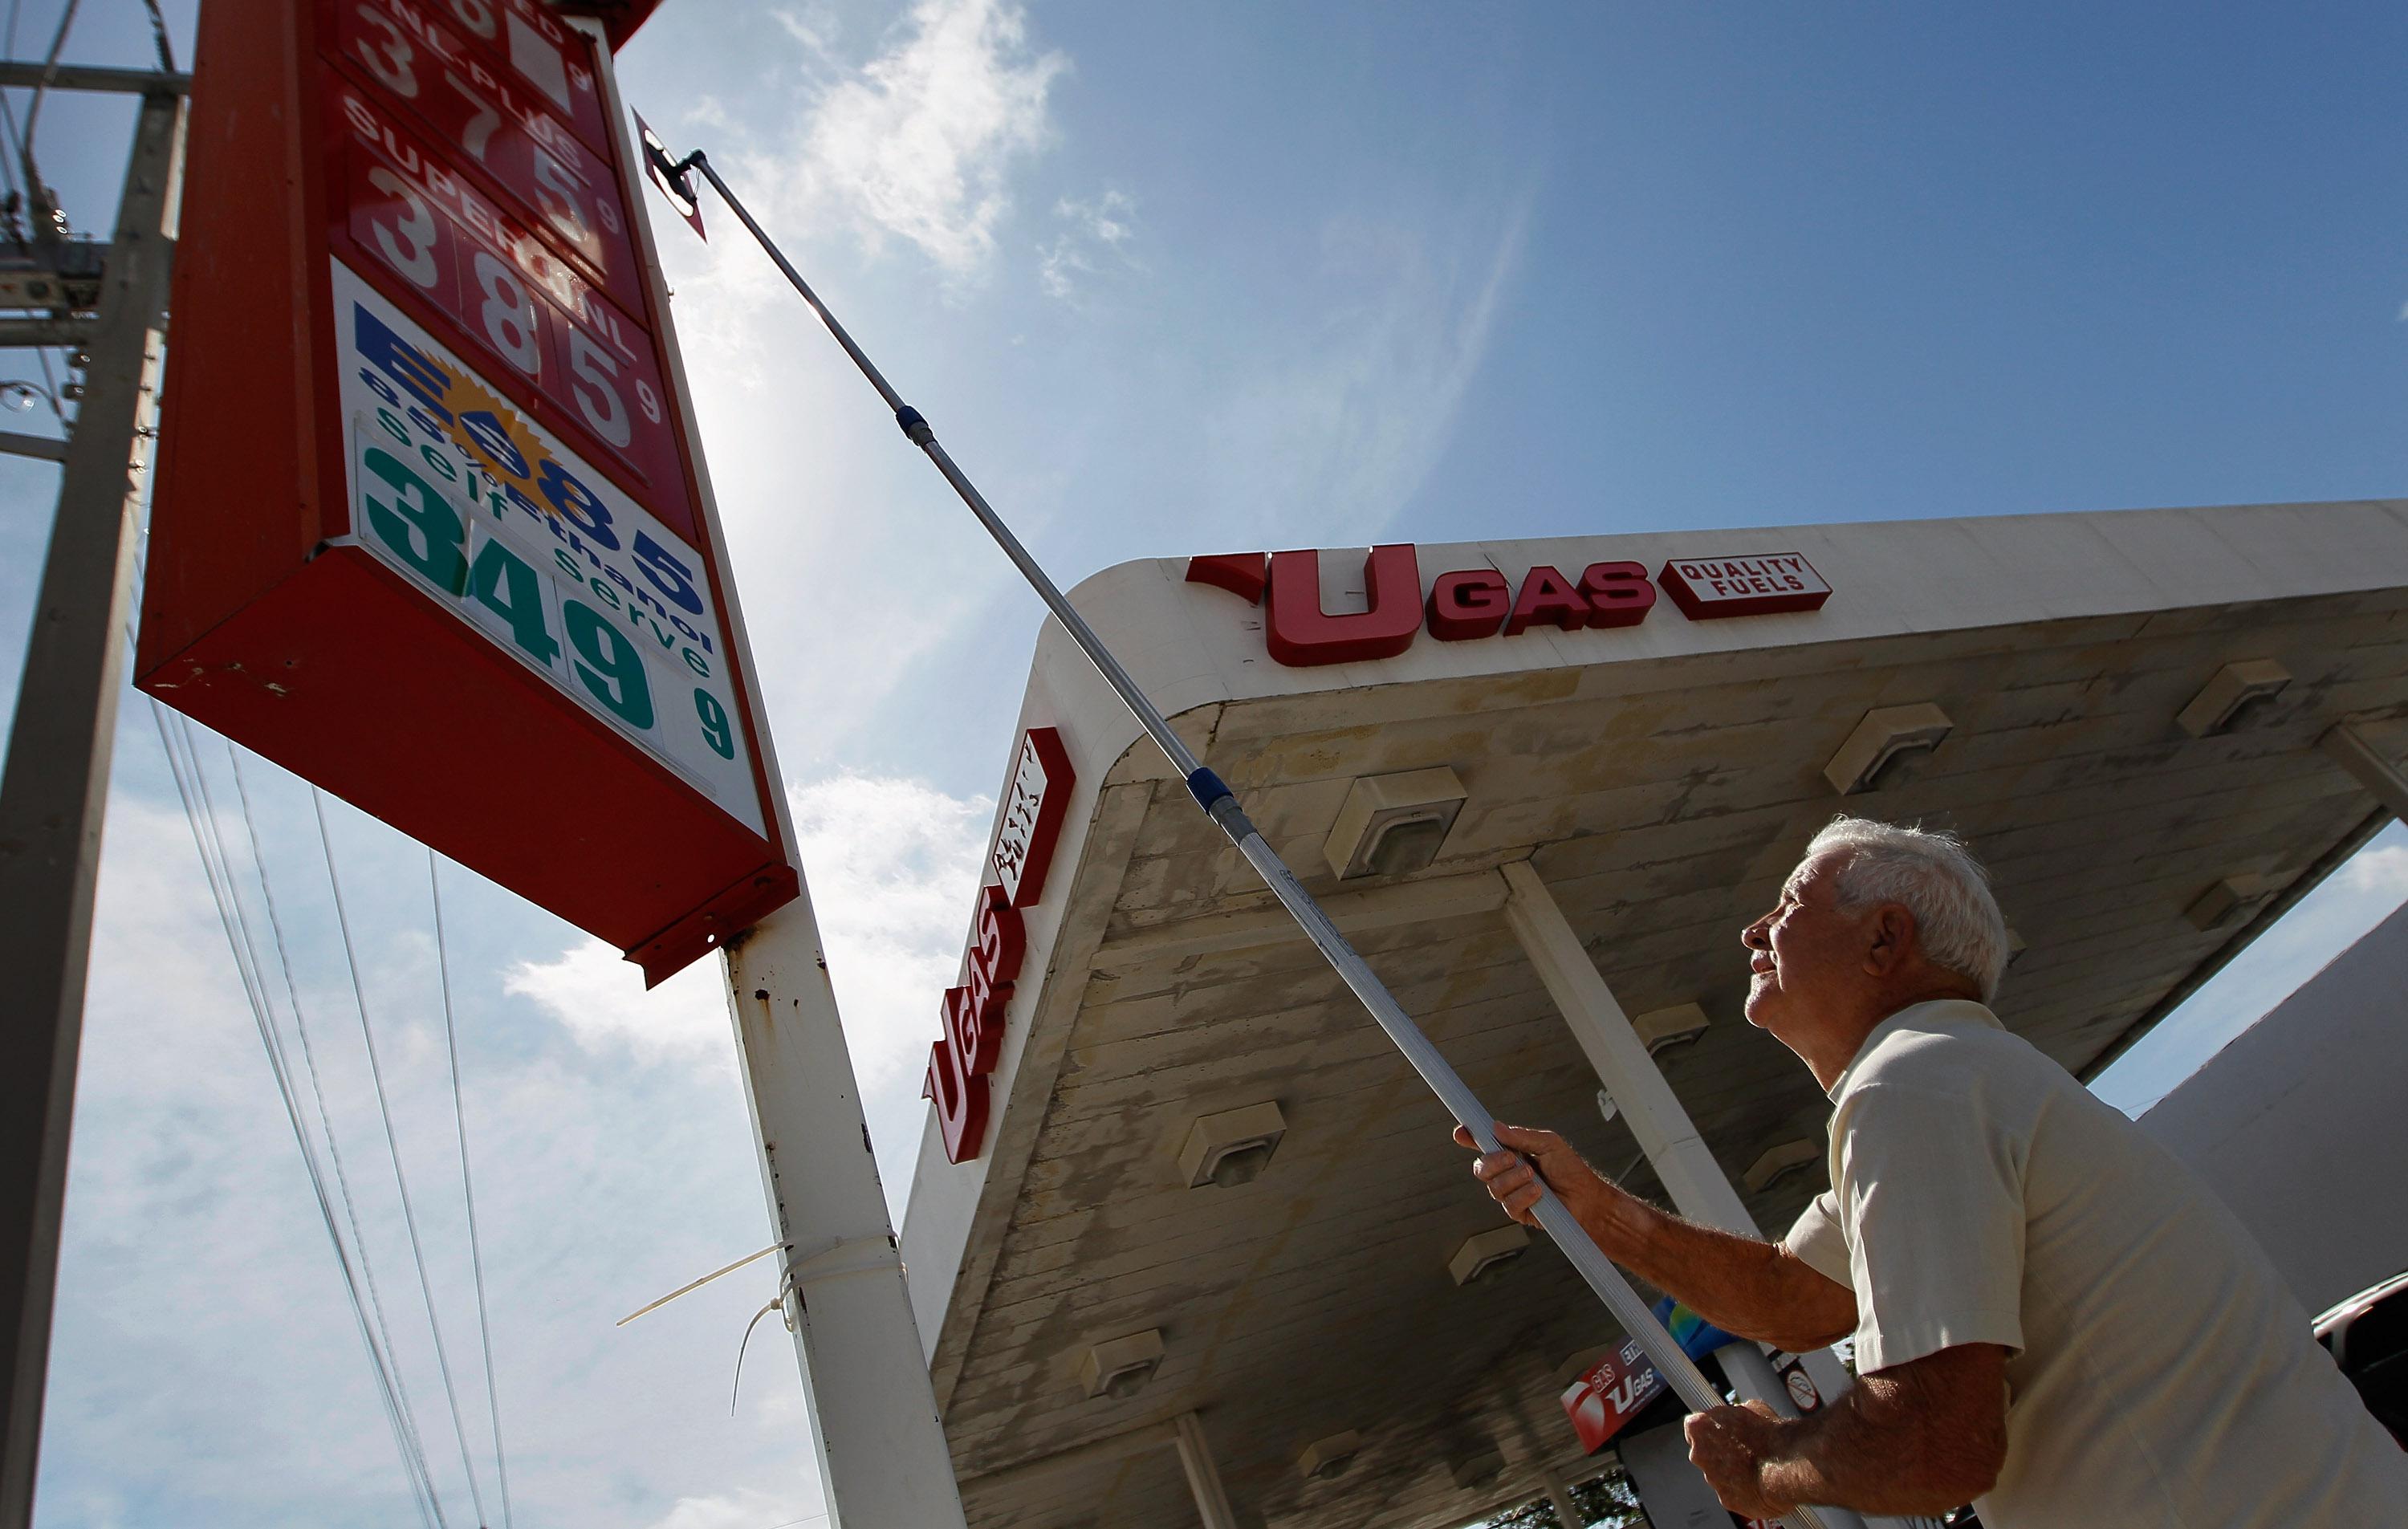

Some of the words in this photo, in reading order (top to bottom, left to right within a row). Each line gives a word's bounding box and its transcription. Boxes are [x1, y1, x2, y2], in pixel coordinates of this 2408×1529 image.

[596, 197, 619, 234] 9
[636, 378, 661, 425] 9
[377, 406, 509, 522] self
[555, 548, 711, 679] serve
[1681, 557, 1804, 580] QUALITY
[1710, 575, 1805, 596] FUELS
[364, 447, 655, 730] 349
[694, 687, 734, 761] 9
